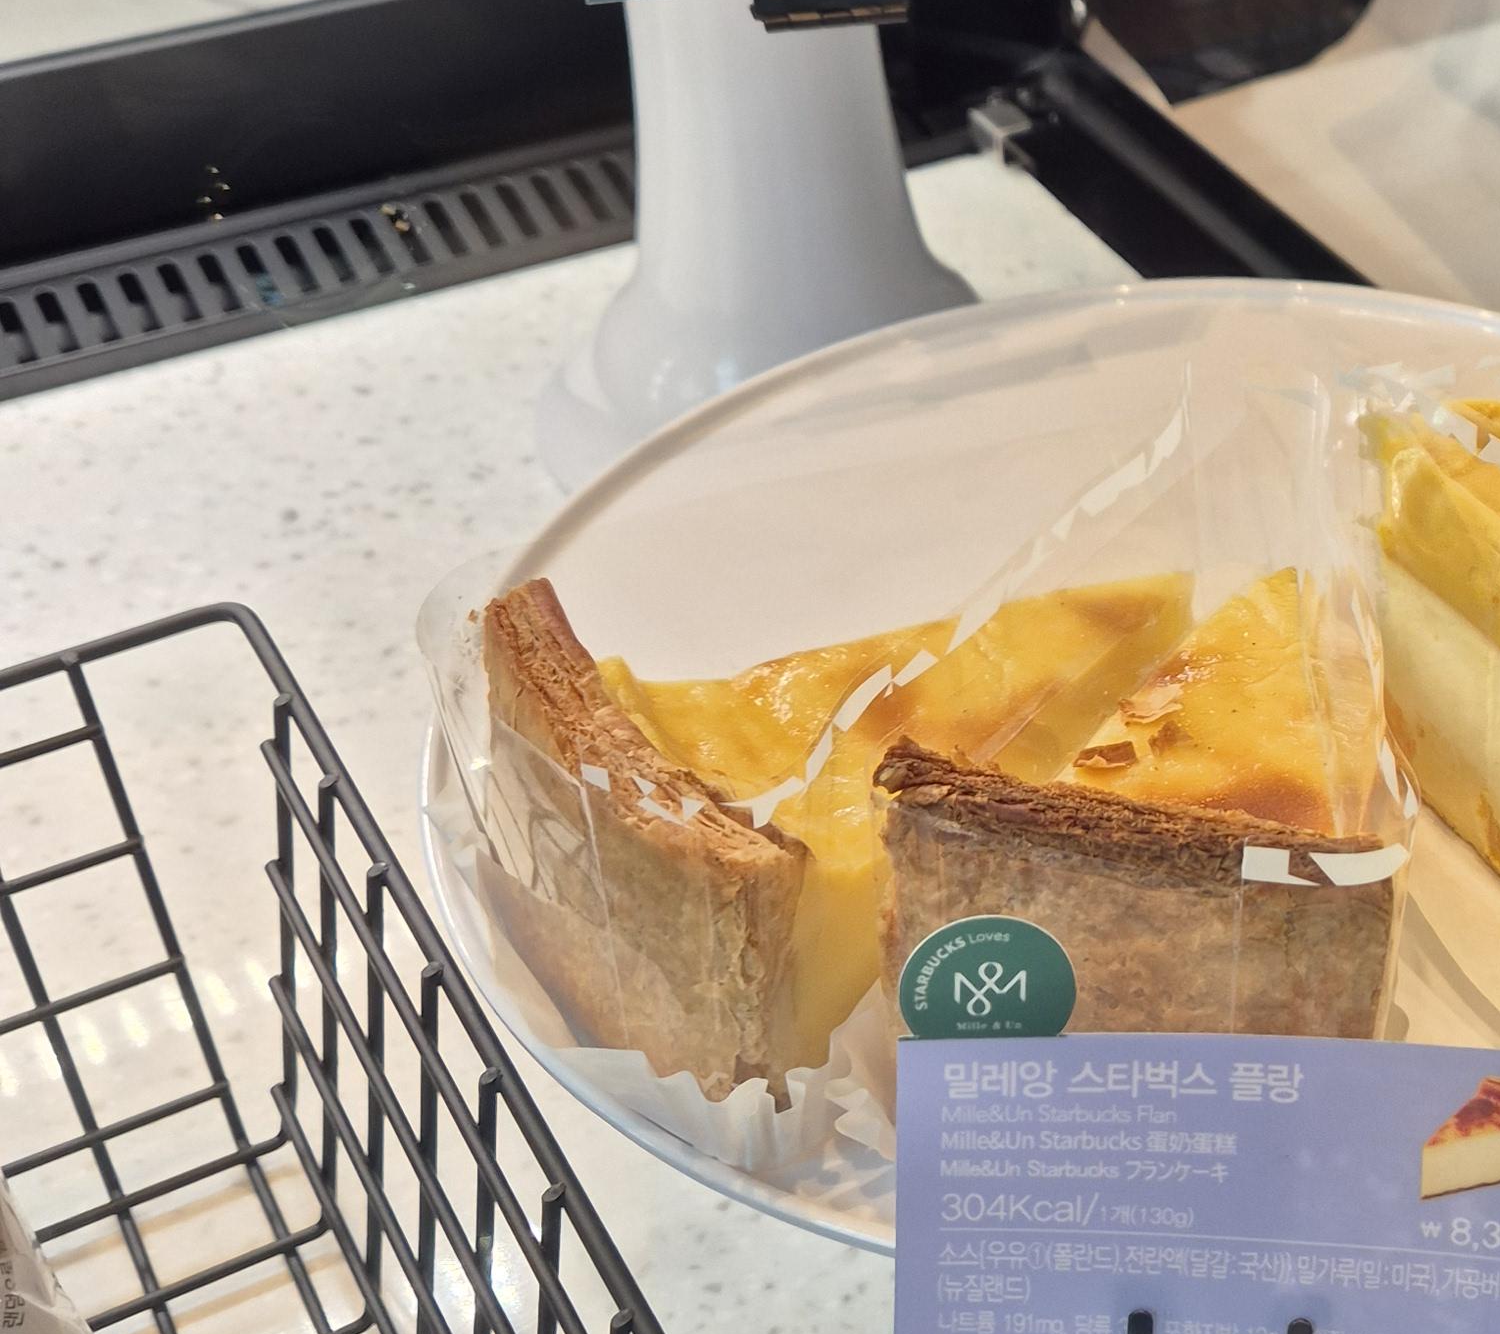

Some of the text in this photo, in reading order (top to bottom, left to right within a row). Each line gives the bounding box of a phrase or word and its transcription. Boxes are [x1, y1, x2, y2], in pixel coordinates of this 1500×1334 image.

[913, 930, 1011, 1011] STARBUCKS Loves
[943, 1058, 1305, 1105] 밀레앙 스타벅스 플랑
[940, 1103, 1178, 1125] Mille&Un Starbucks Flan
[940, 1130, 1036, 1152] Mille&Un
[1038, 1130, 1144, 1153] Starbucks
[939, 1158, 1230, 1184] Mille&Un Starbucks フランケーキ
[936, 1273, 1032, 1305] (뉴질랜드)
